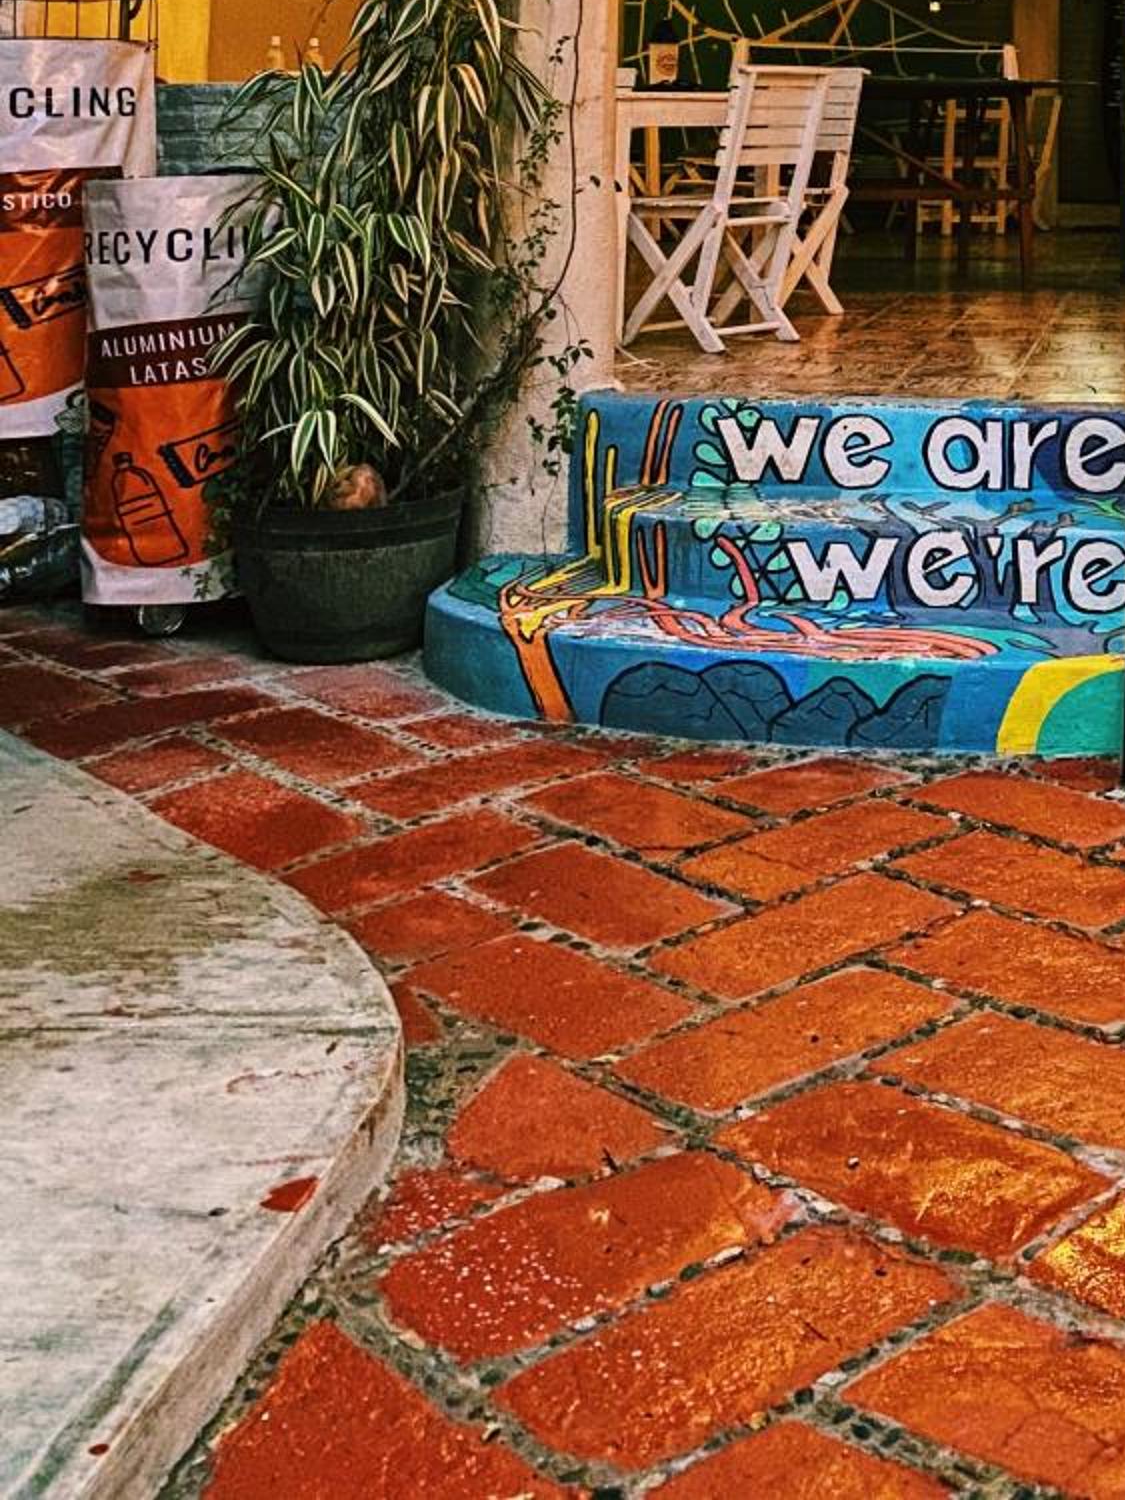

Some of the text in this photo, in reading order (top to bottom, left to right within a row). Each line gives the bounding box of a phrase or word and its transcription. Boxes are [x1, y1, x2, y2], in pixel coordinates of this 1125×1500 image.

[8, 86, 136, 119] CLING
[2, 192, 72, 211] STICO
[100, 321, 237, 358] ALUMINIUM
[129, 356, 207, 386] LATAS
